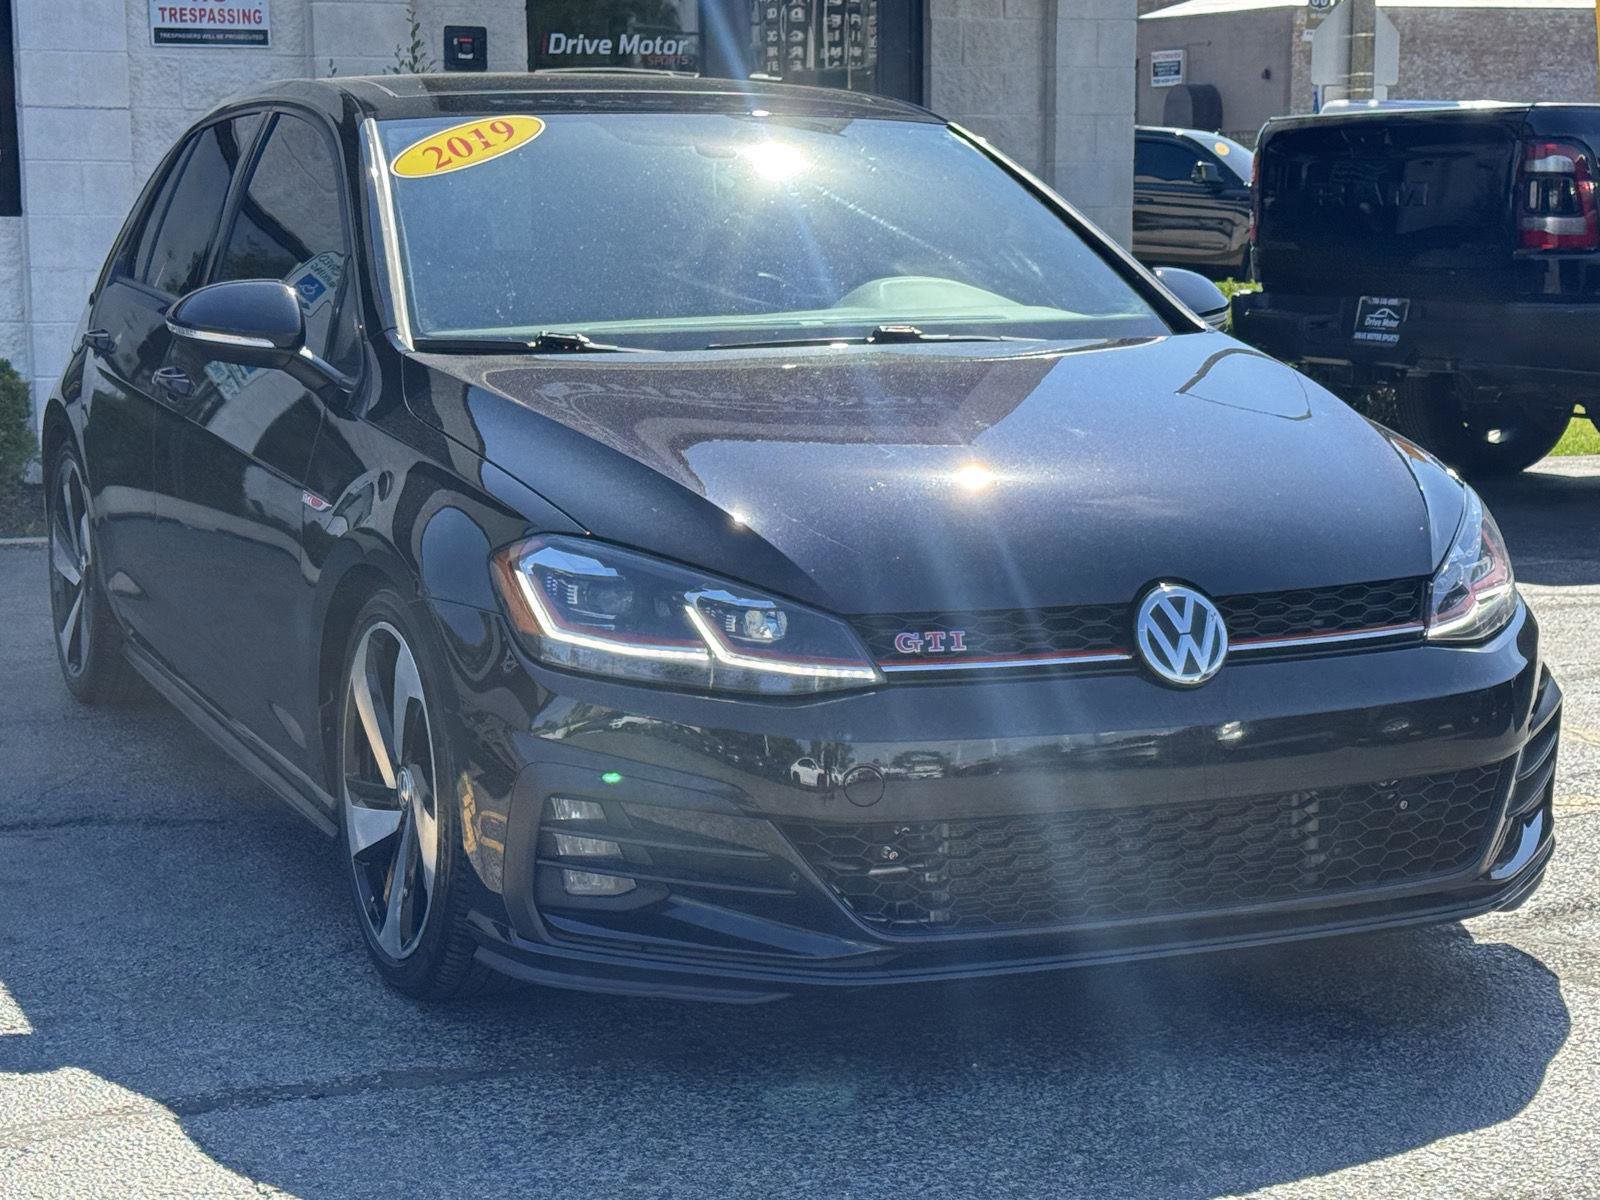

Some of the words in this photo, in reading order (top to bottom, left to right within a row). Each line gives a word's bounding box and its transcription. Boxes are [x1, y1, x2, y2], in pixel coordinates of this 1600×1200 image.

[158, 7, 263, 25] TRESPASSING
[548, 33, 613, 55] Drive
[618, 34, 690, 55] Motor
[422, 120, 515, 170] 2019
[895, 630, 967, 653] GTI
[1142, 592, 1219, 679] VW
